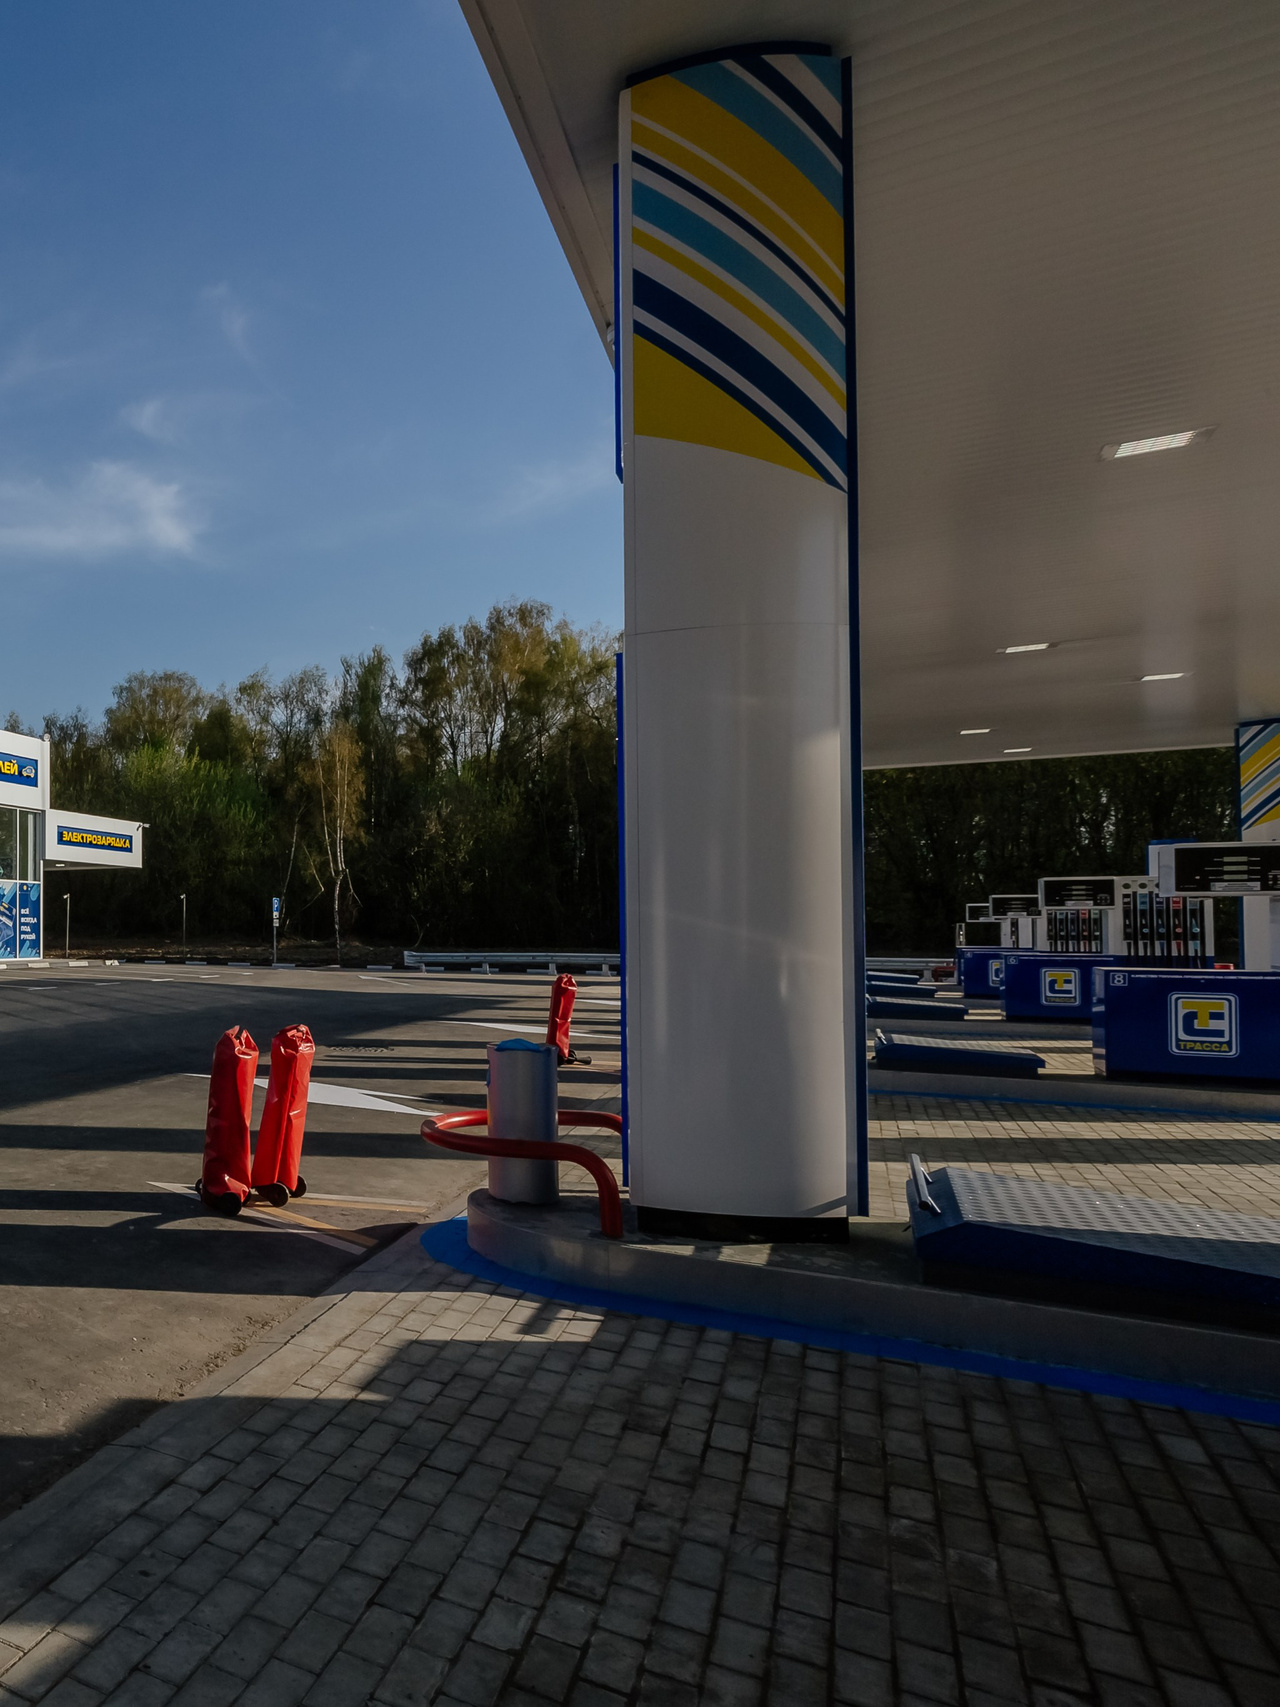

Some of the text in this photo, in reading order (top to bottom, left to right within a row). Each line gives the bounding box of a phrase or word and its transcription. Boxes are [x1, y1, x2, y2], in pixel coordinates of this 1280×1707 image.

[62, 830, 130, 848] ЭЛЕКТРОЗАРЯДКА
[1114, 974, 1124, 985] 8
[1178, 1042, 1230, 1052] ТРАССА
